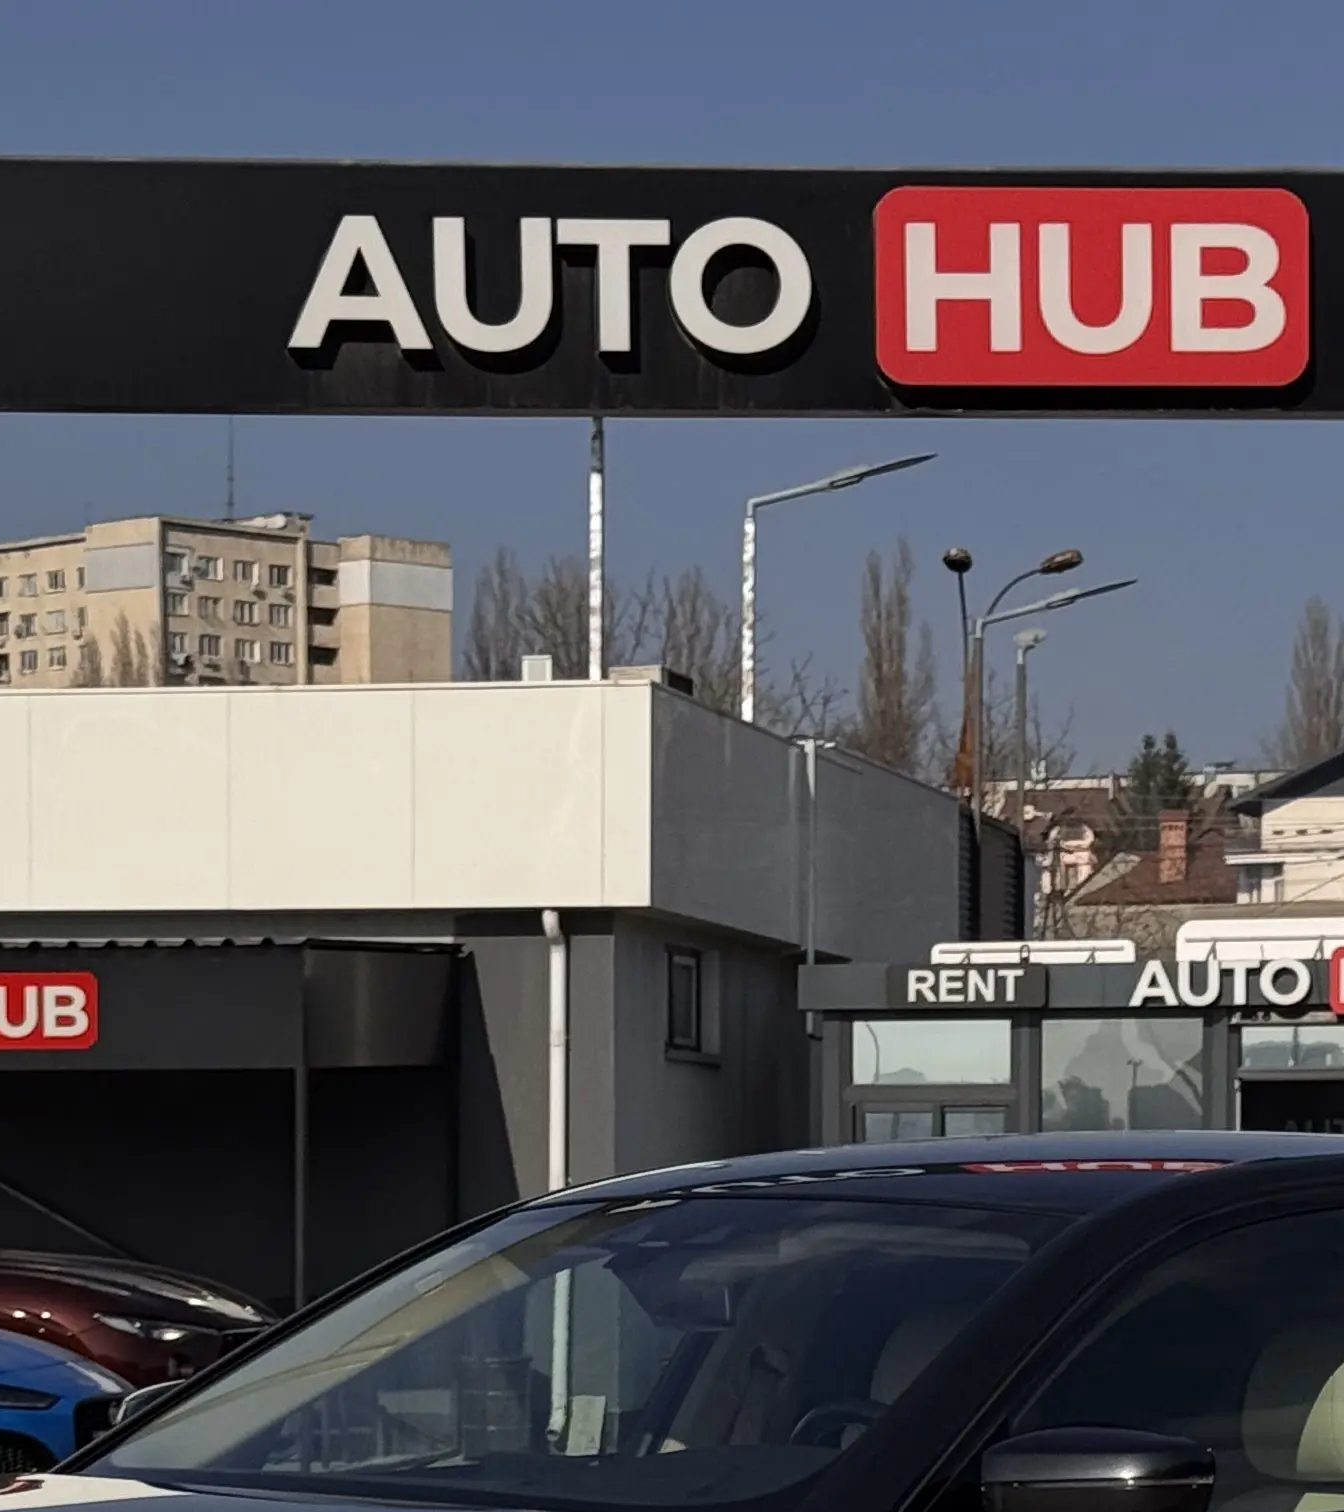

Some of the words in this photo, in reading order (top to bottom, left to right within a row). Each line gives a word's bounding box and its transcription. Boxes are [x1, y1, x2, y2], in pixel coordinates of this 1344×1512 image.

[288, 215, 812, 353] AUTO
[905, 222, 1286, 354] HUB
[907, 969, 1026, 1003] RENT
[1128, 957, 1312, 1008] AUTO
